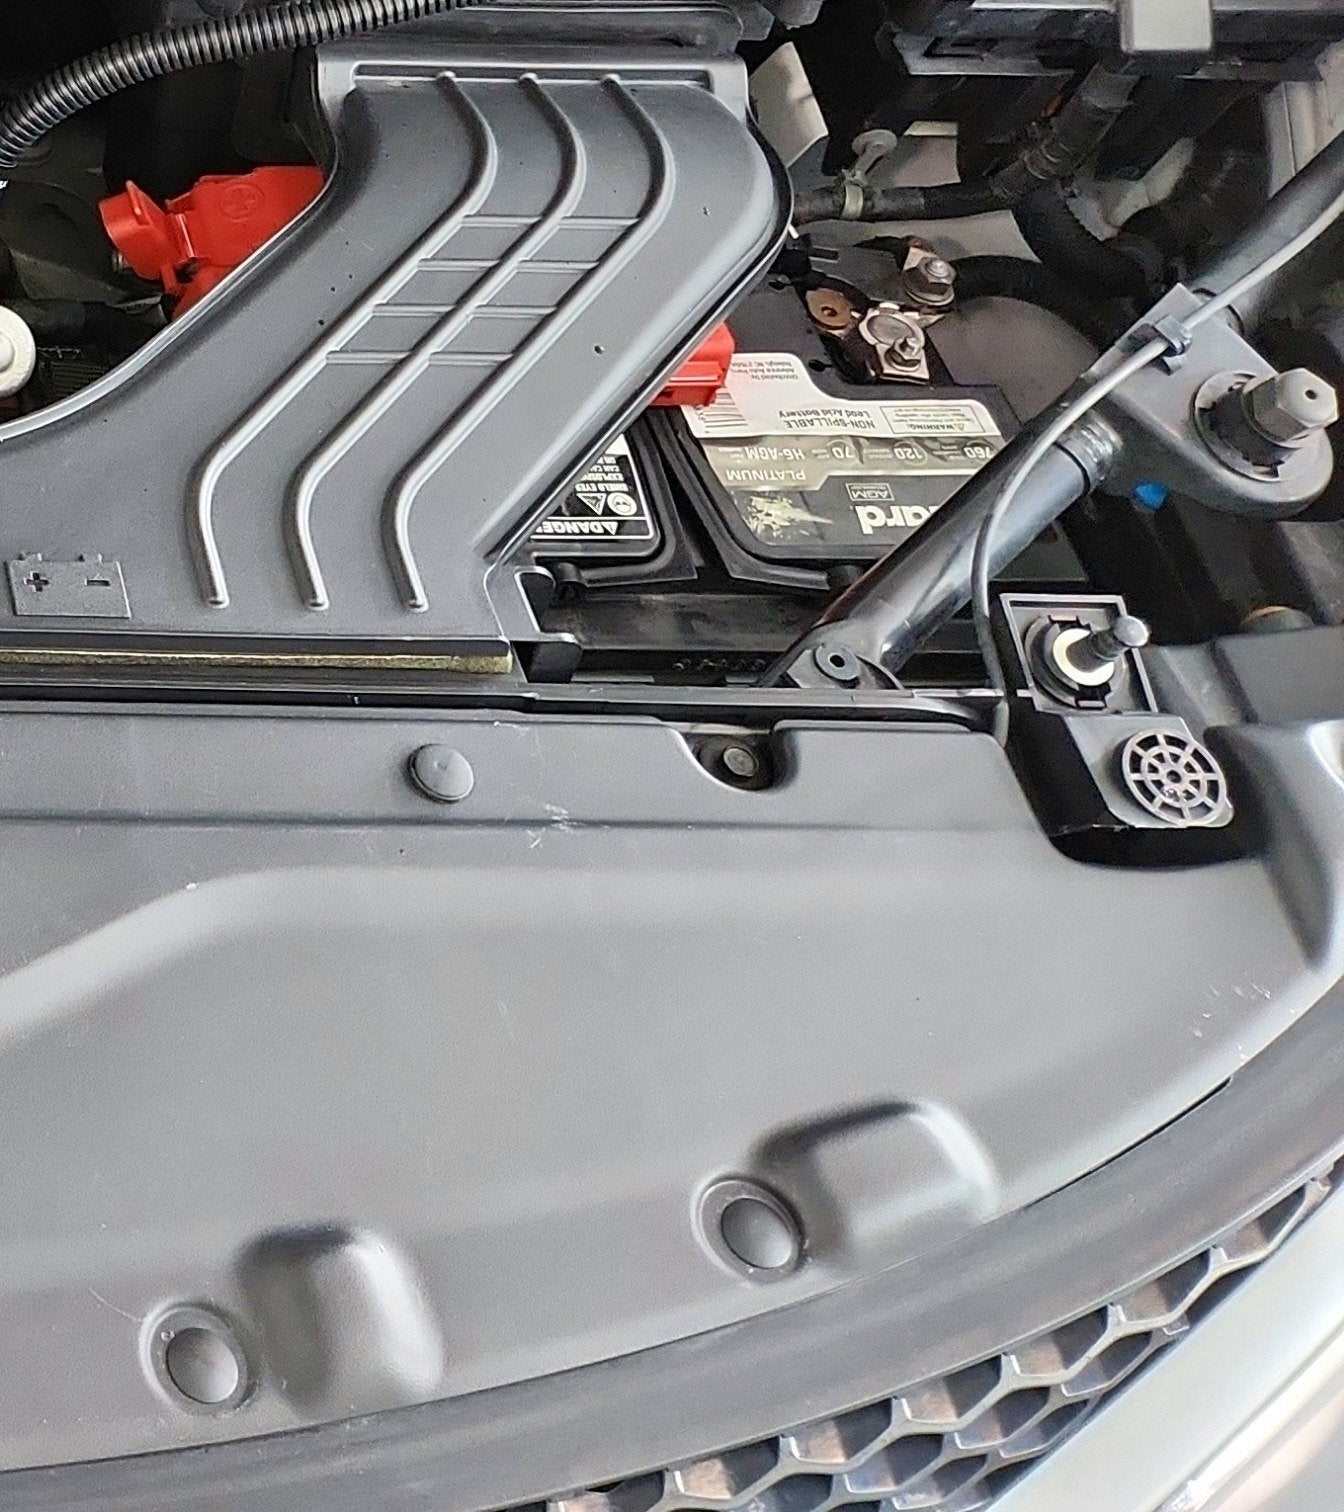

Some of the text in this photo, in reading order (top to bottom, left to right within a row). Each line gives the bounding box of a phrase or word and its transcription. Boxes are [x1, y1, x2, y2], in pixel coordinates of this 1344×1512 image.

[821, 409, 843, 418] Acid
[845, 410, 870, 419] Lead
[783, 417, 876, 430] NON-SPILLABLE
[831, 447, 852, 459] 70
[894, 447, 922, 459] 120
[725, 469, 807, 481] PLATINUM
[851, 490, 889, 499] AGM
